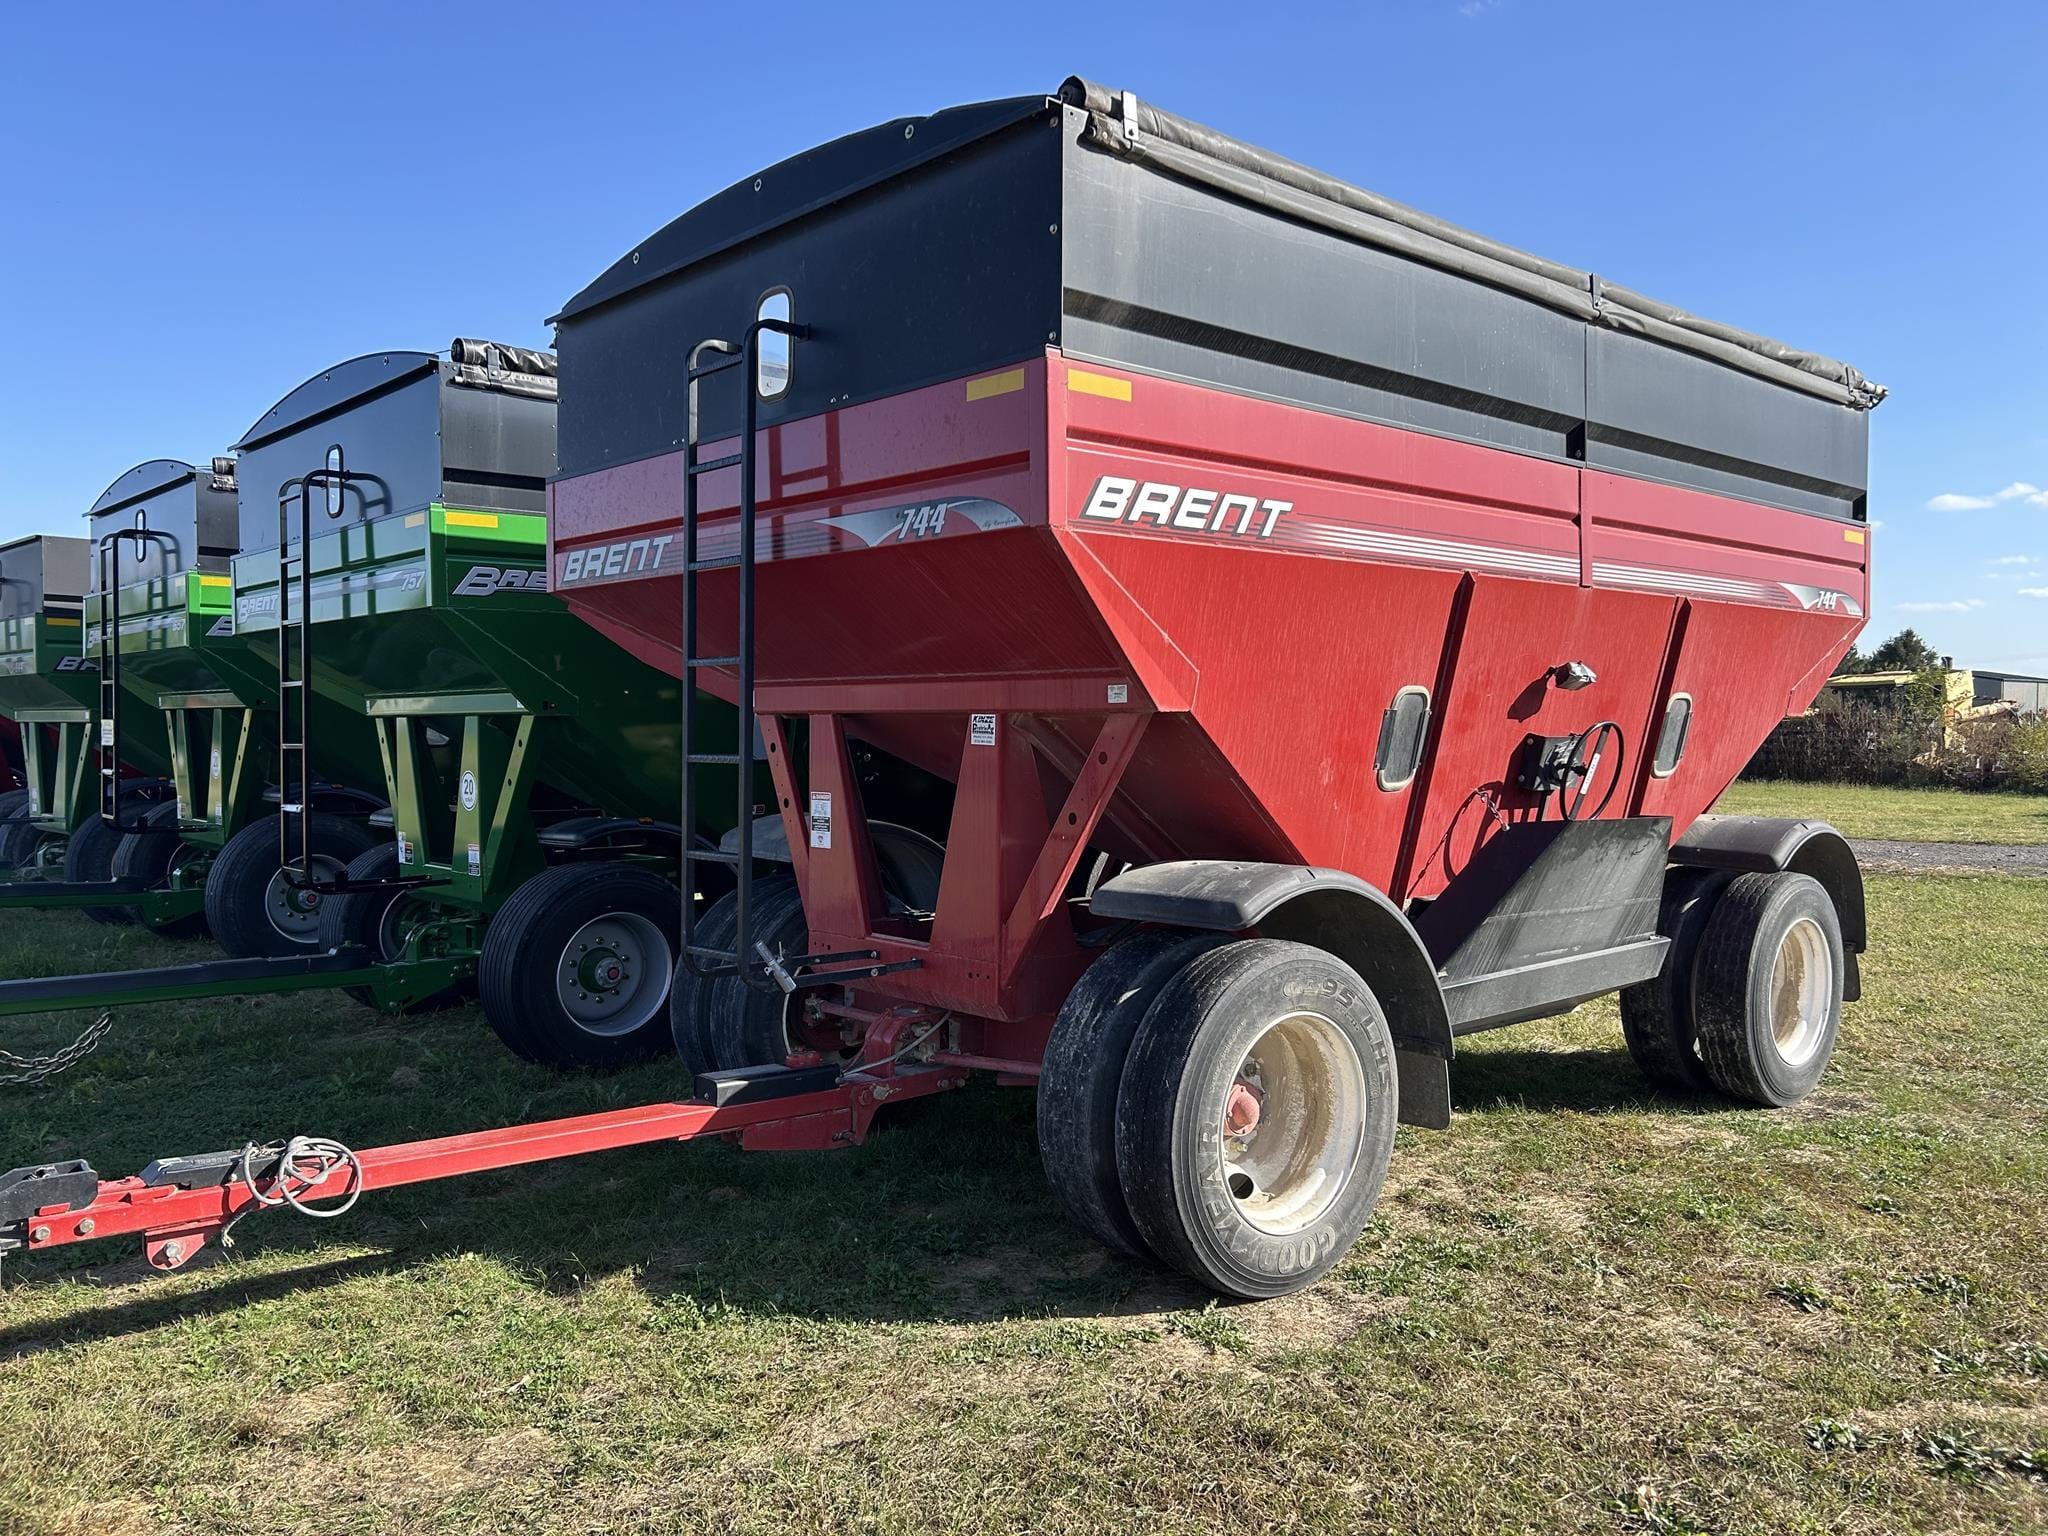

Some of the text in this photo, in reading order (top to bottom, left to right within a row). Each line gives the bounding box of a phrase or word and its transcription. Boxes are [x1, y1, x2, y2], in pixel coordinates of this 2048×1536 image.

[1080, 475, 1294, 538] BRENT
[898, 503, 948, 541] 744
[561, 535, 674, 582] BRENT
[401, 571, 426, 592] 757
[452, 566, 547, 596] BRE
[237, 594, 279, 625] BRENT
[1816, 590, 1838, 610] 744
[464, 779, 474, 795] 20
